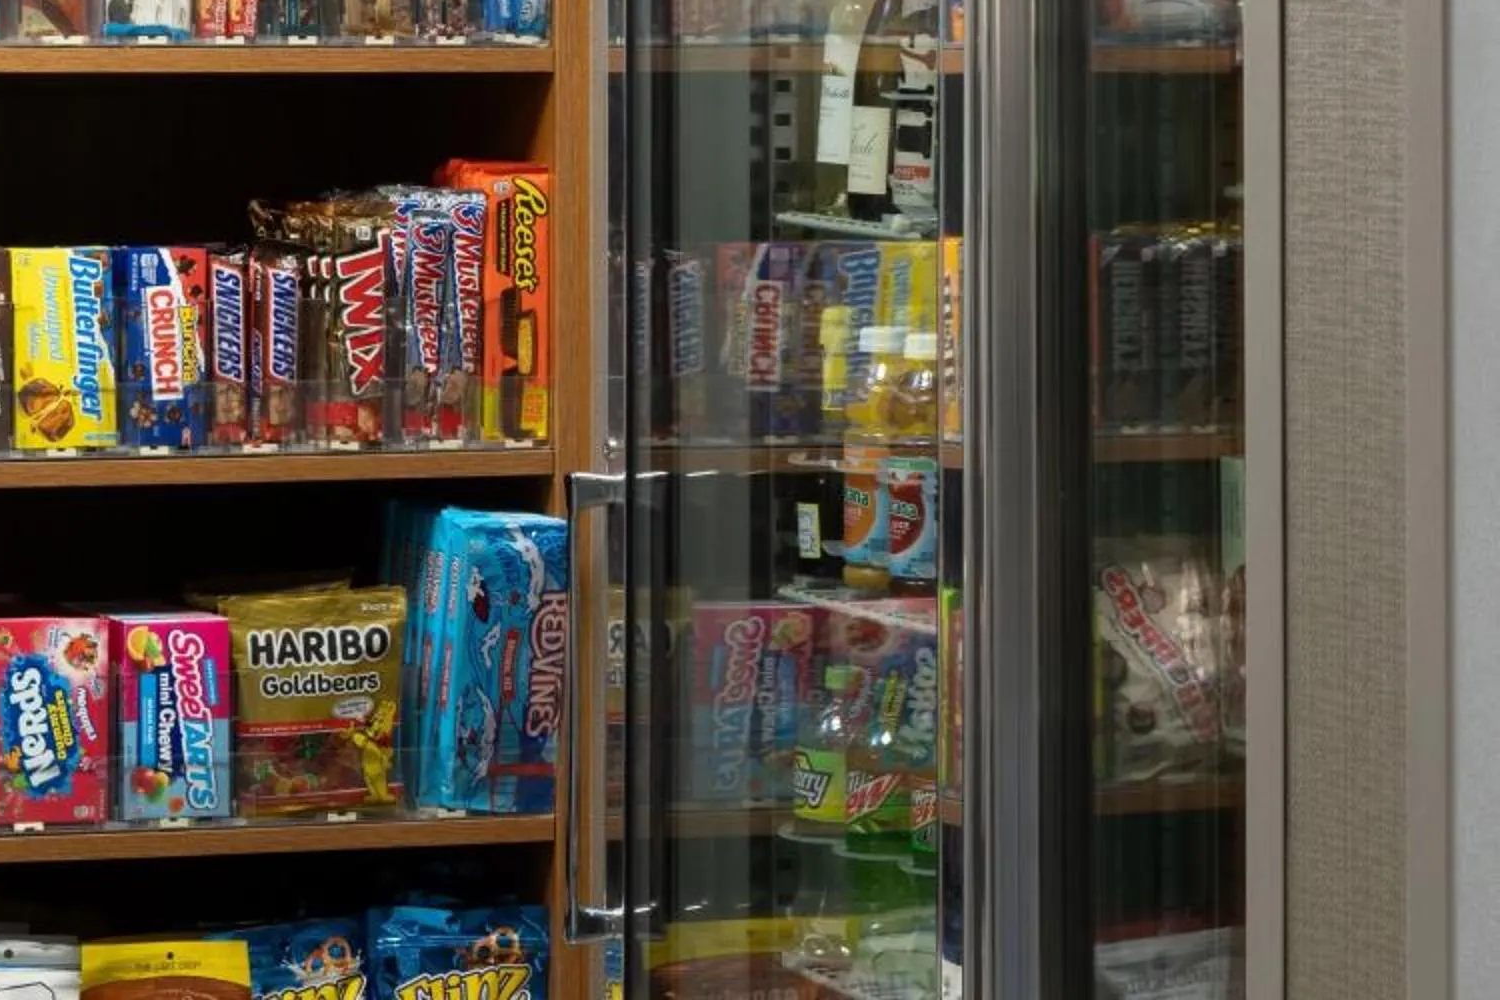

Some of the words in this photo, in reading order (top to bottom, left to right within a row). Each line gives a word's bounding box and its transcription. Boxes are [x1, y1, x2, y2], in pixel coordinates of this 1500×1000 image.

[512, 176, 546, 293] Reese's
[69, 255, 103, 421] Butterfinger
[150, 290, 180, 395] CRUNCH
[215, 269, 242, 380] SNICKERS
[272, 271, 297, 382] SNICKERS
[336, 229, 391, 395] TWIX
[250, 627, 389, 667] HARIBO
[532, 592, 567, 658] RED
[160, 672, 173, 705] mini
[262, 672, 379, 697] Goldbears
[526, 654, 565, 737] VINES
[157, 708, 176, 773] Chewy
